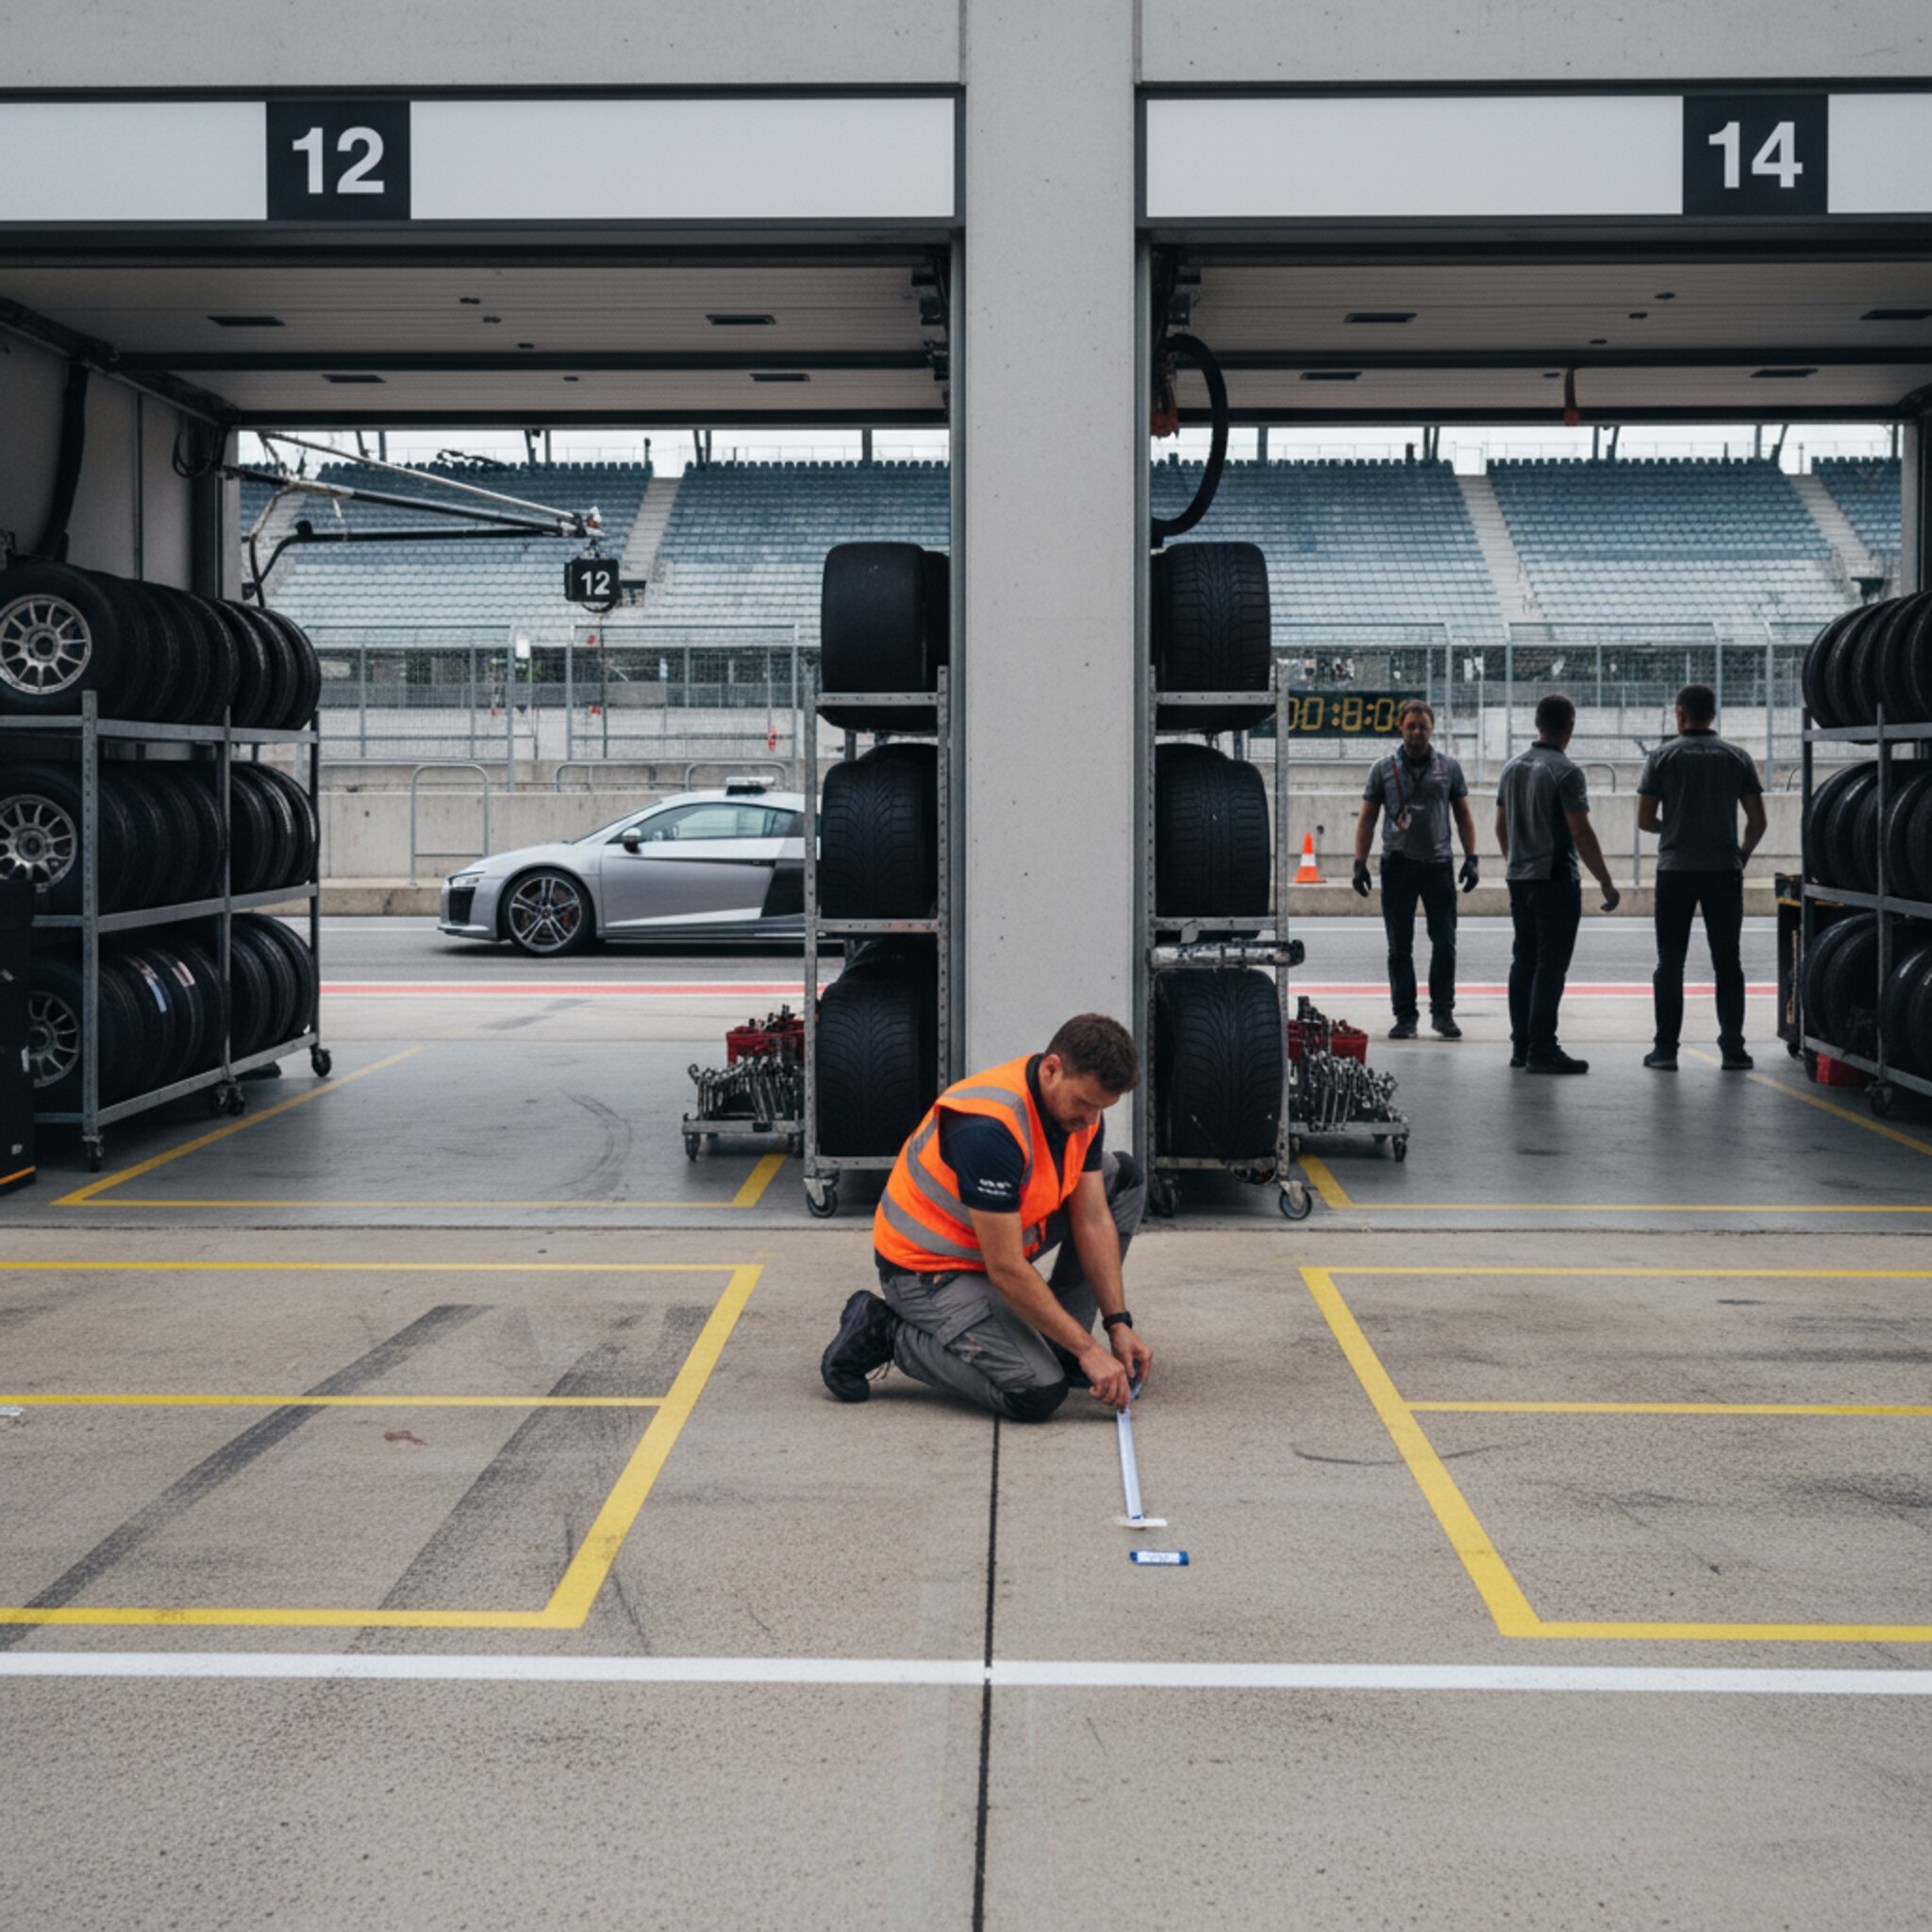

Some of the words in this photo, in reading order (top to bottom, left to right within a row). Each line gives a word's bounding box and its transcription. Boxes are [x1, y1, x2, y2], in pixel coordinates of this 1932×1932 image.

[291, 126, 385, 194] 12
[1708, 122, 1803, 189] 14
[580, 570, 610, 596] 12
